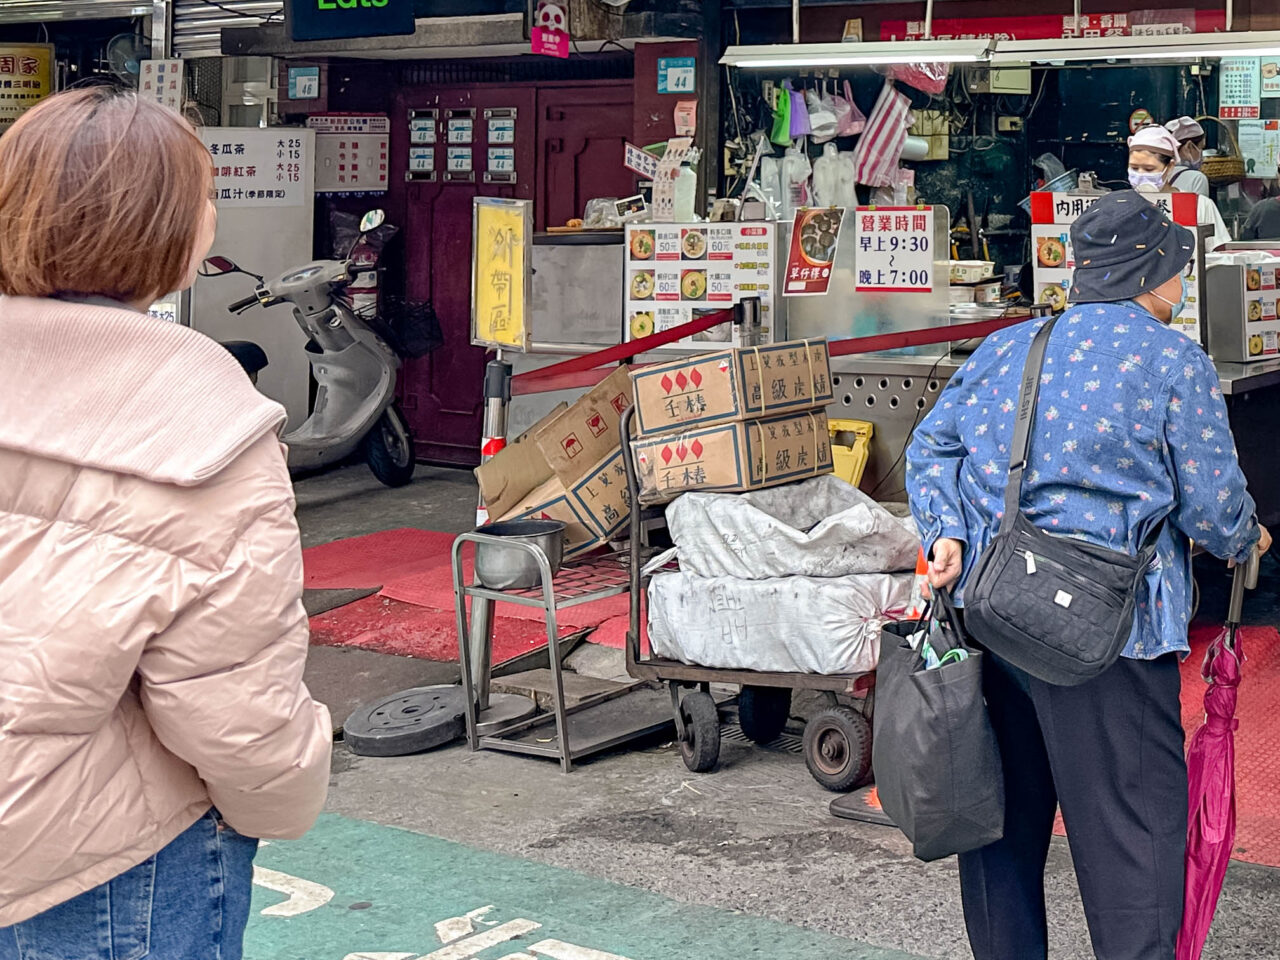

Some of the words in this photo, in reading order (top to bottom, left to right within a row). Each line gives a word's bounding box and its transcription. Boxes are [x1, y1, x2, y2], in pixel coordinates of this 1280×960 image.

[674, 76, 687, 88] 44
[209, 143, 245, 155] 冬瓜茶
[277, 140, 285, 148] 大
[288, 139, 301, 148] 25
[276, 150, 284, 159] 小
[288, 150, 300, 159] 15
[276, 163, 284, 172] 大
[287, 163, 299, 172] 25
[276, 173, 284, 182] 小
[288, 173, 299, 182] 15
[861, 214, 927, 232] 營業時間
[860, 236, 929, 252] 早上9:30
[789, 267, 821, 280] 草仔粿
[859, 269, 929, 285] 晚上7:00
[752, 374, 826, 404] 高級炭精
[756, 443, 827, 477] 高級炭精
